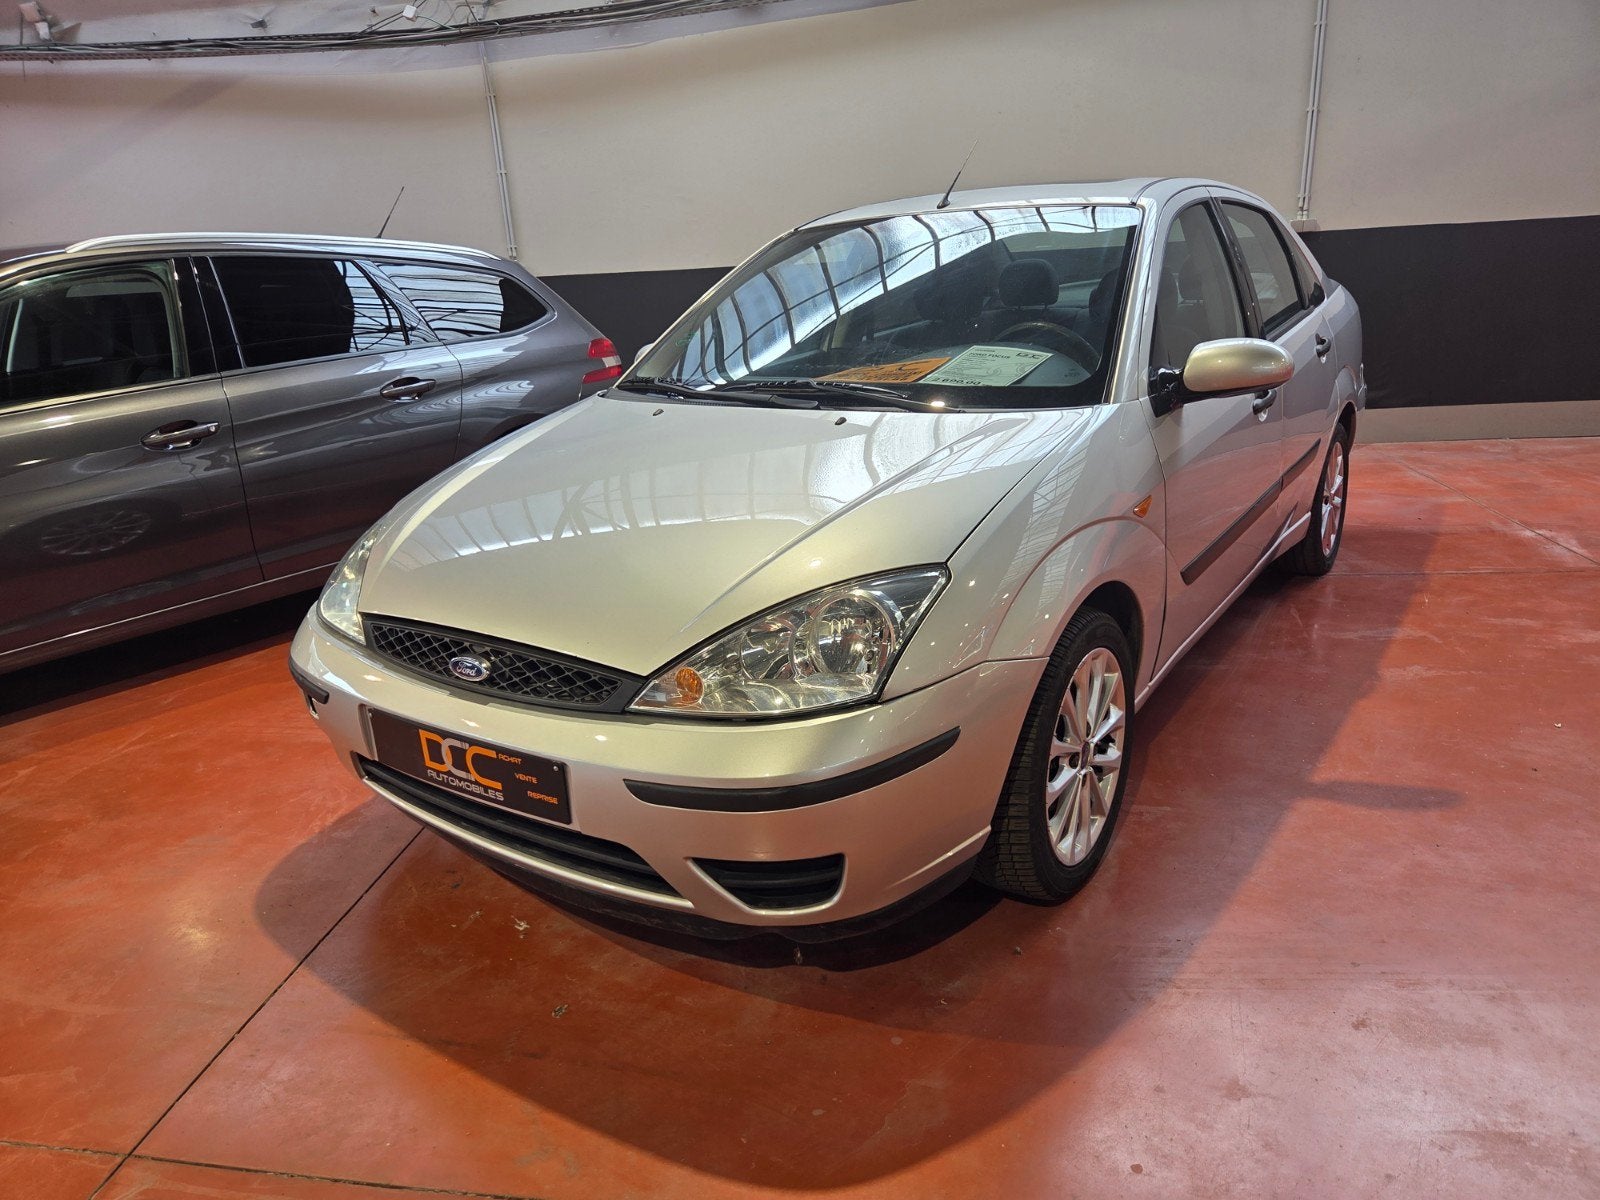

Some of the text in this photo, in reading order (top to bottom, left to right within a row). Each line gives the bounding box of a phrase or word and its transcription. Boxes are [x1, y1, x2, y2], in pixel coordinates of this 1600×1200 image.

[456, 660, 477, 676] Ford
[498, 754, 522, 765] ACHAT
[427, 769, 504, 801] AUTOMOBILES
[514, 772, 538, 784] VENTE
[527, 790, 559, 804] REPRISE
